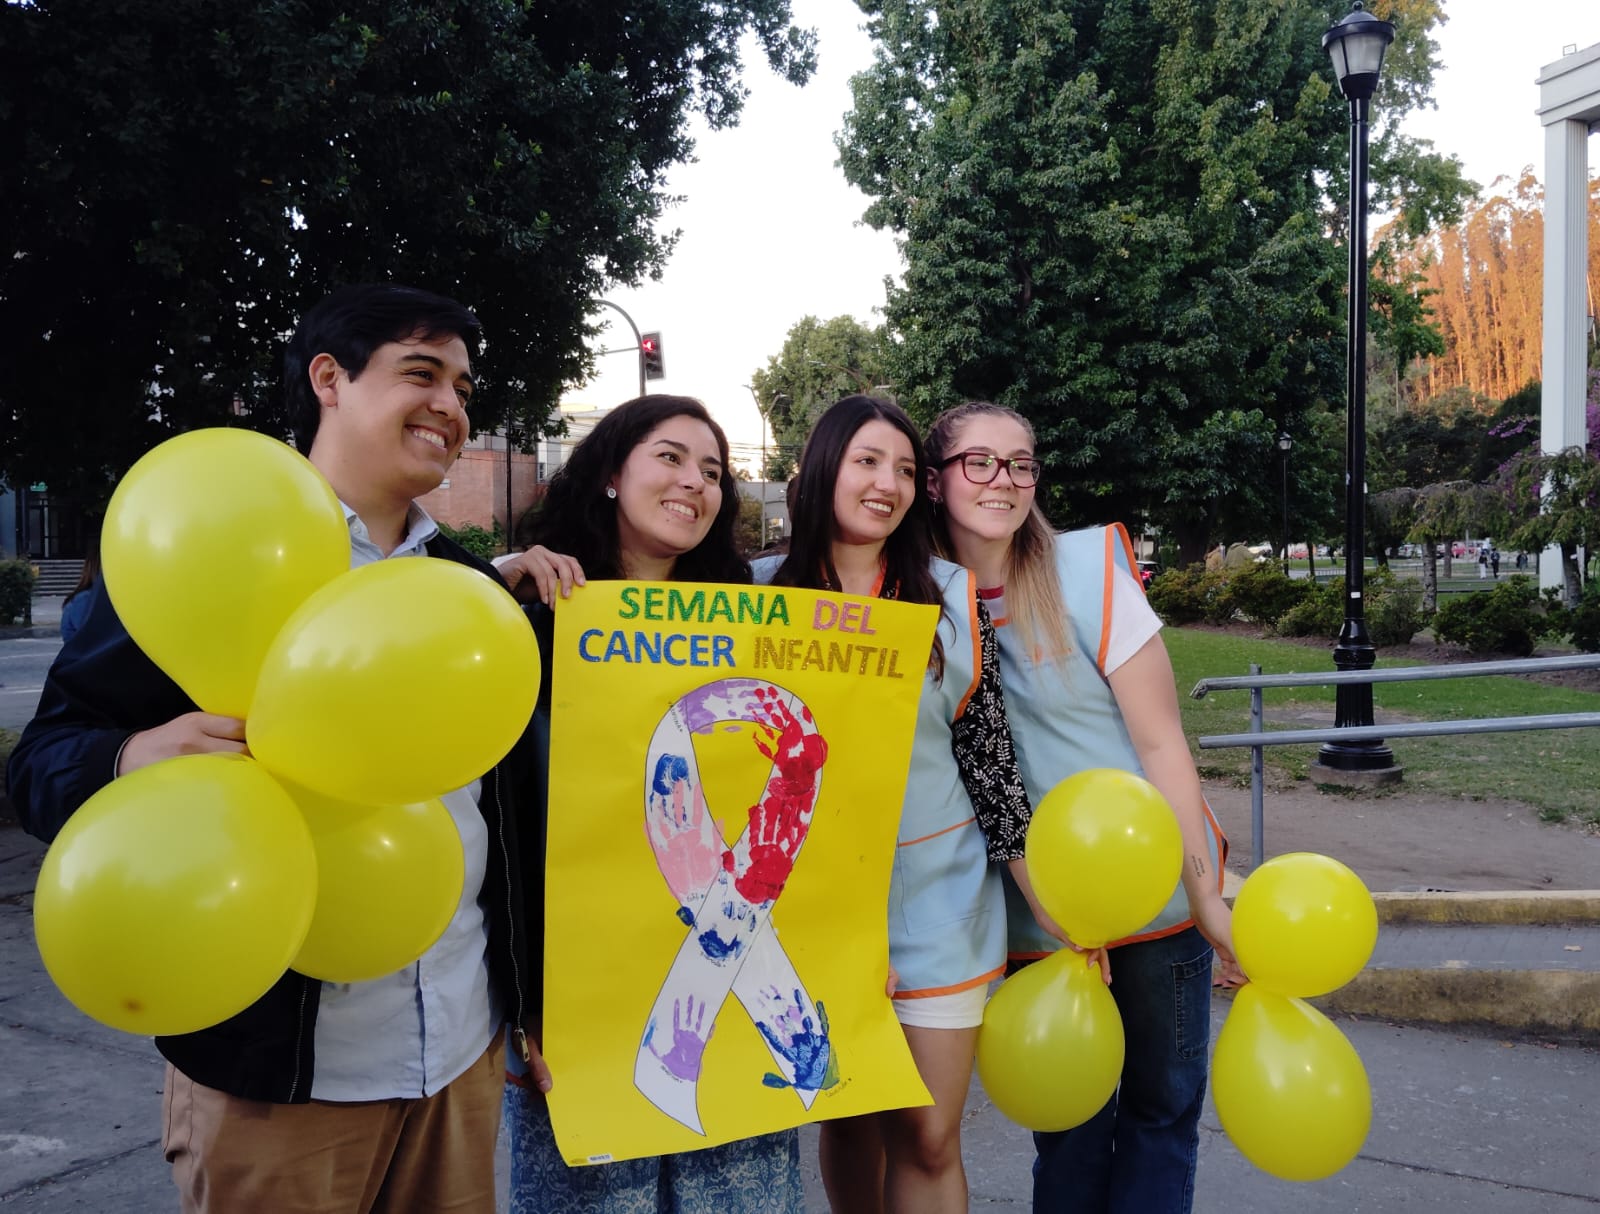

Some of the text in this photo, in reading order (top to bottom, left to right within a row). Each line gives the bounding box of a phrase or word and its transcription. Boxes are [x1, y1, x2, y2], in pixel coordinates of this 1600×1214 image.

[619, 587, 876, 634] SEMANA DEL
[578, 629, 904, 679] CANCER INFANTIL
